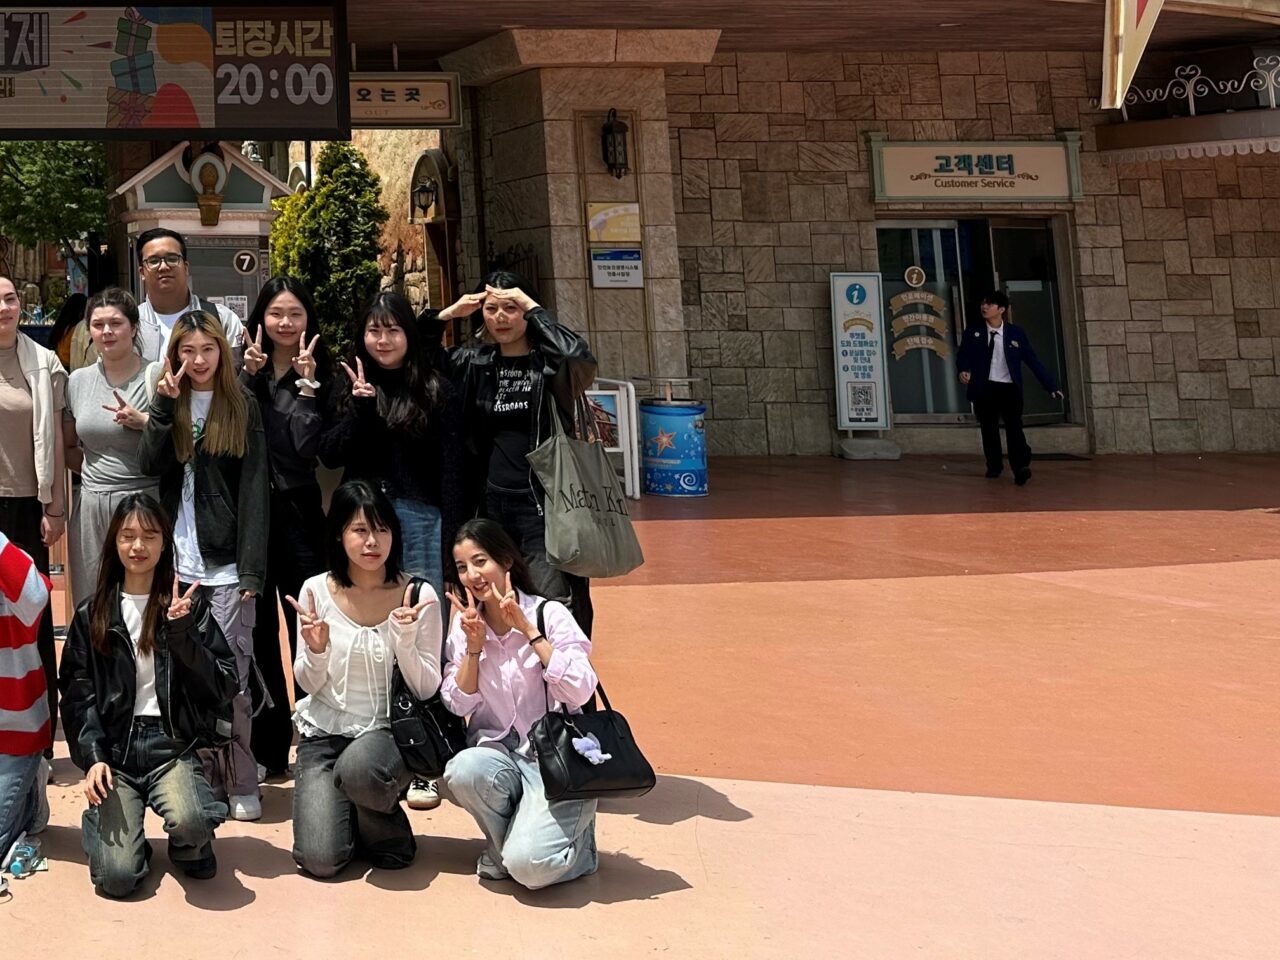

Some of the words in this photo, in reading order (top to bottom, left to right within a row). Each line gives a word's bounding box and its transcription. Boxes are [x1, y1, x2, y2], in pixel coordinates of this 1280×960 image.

[215, 19, 334, 57] 퇴장시간
[215, 63, 334, 106] 20:00
[933, 154, 1015, 175] 고객센터
[934, 178, 978, 188] Customer
[981, 178, 1016, 188] Service
